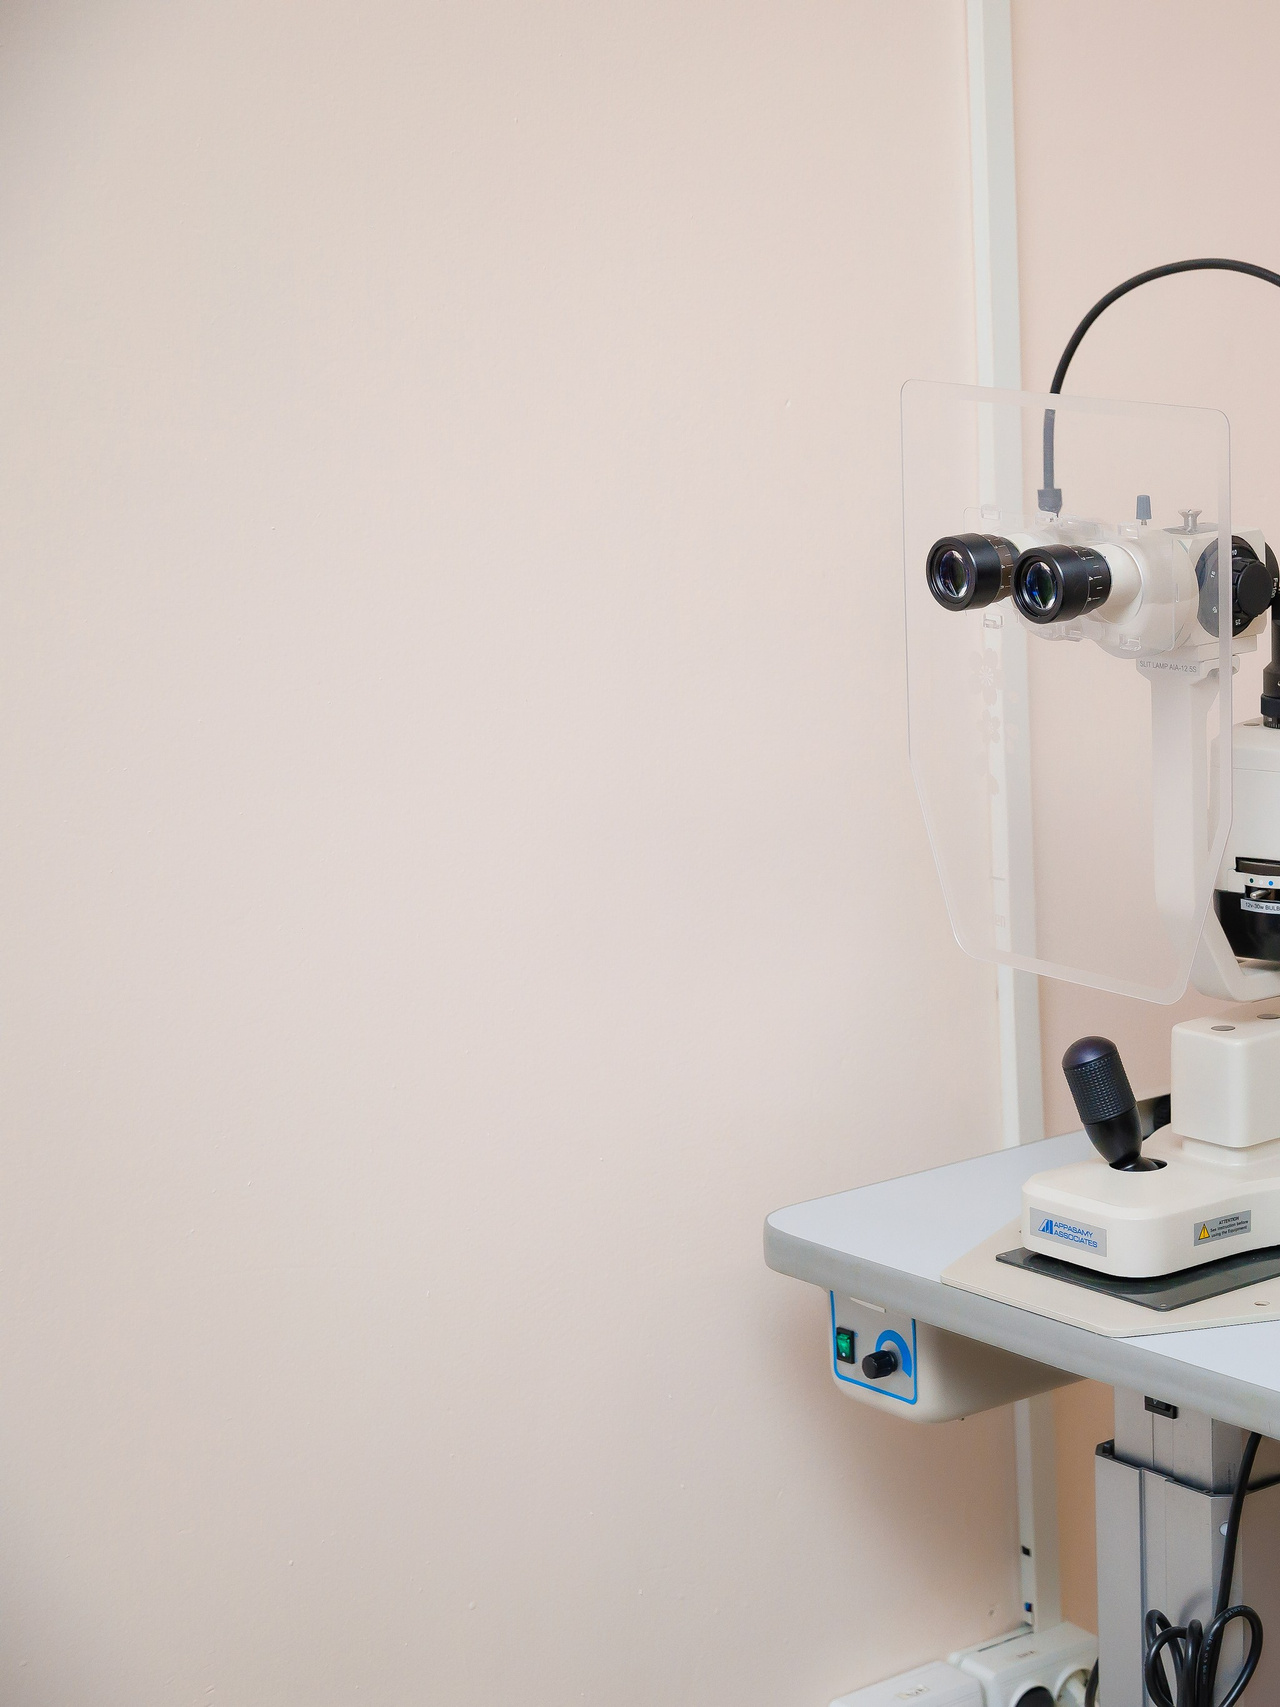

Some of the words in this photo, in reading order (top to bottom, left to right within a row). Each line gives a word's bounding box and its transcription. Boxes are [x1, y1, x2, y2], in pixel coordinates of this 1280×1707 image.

[1140, 660, 1151, 668] SLIT
[1152, 662, 1168, 670] LAMP
[1219, 1216, 1239, 1225] ATTENTION
[1054, 1222, 1093, 1238] APPASAMY
[1054, 1230, 1098, 1248] ASSOCIATES
